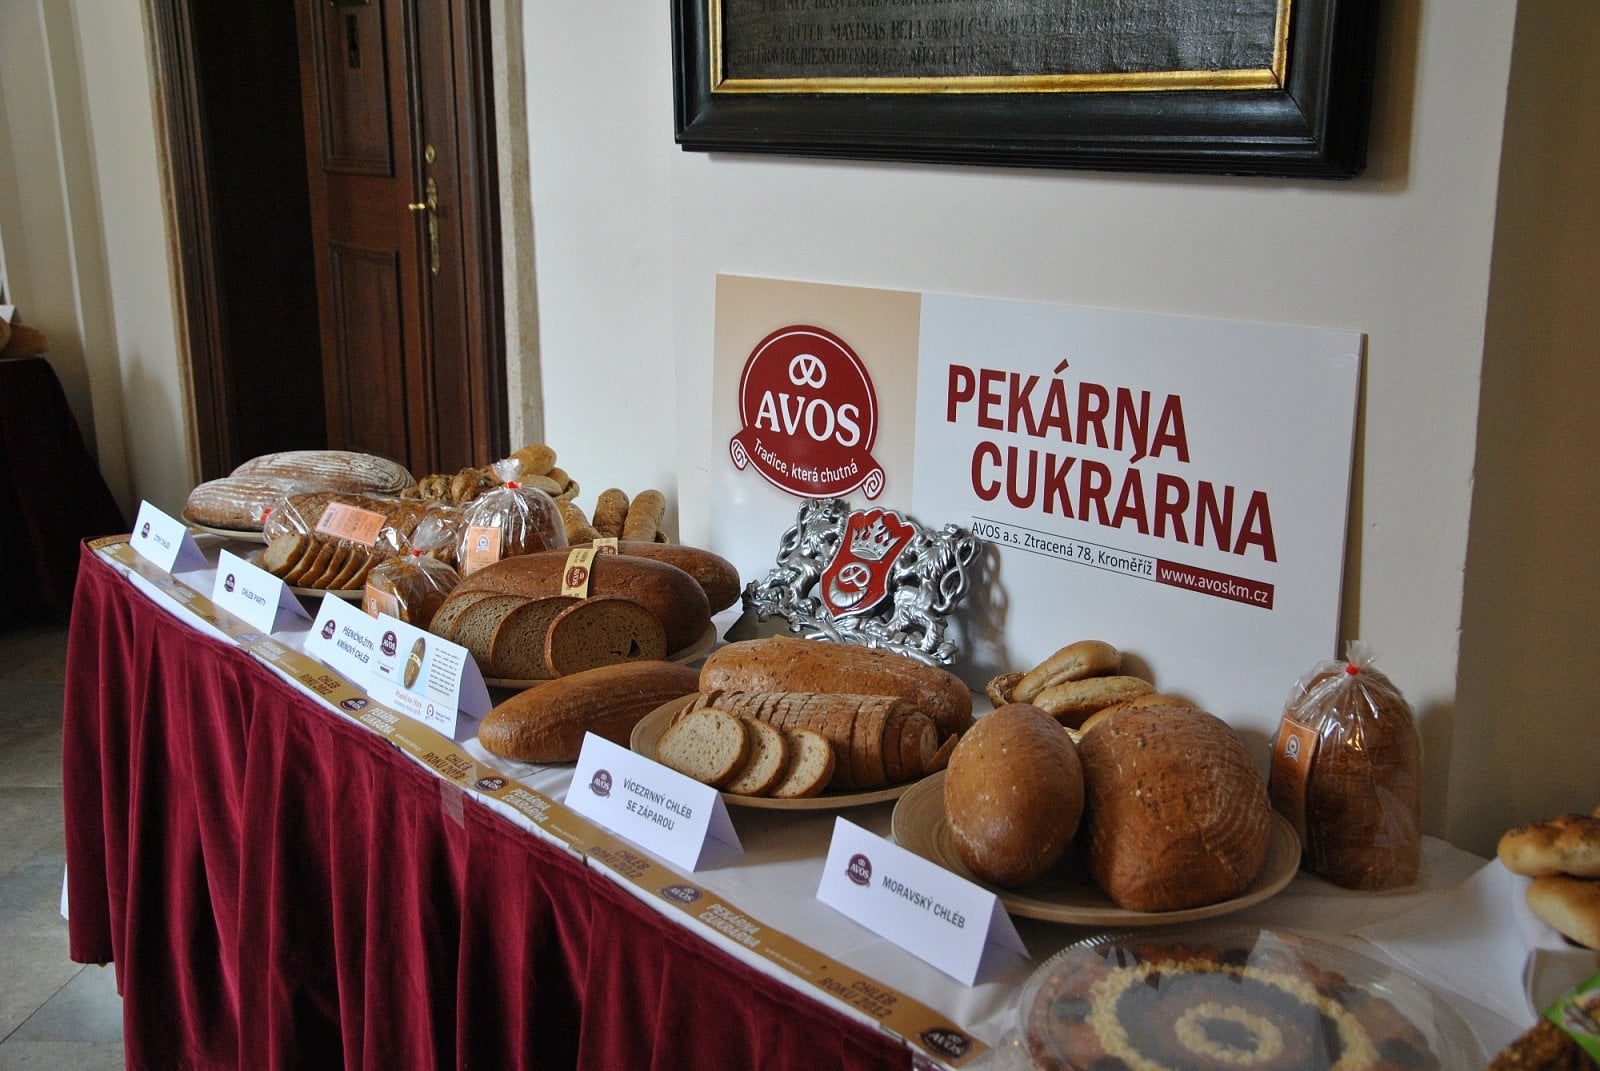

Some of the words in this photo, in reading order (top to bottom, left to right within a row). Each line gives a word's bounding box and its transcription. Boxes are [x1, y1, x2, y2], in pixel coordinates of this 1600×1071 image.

[754, 390, 861, 447] AVOS
[946, 358, 1190, 463] PEKÁRNA
[753, 438, 789, 477] Tradice,
[791, 462, 819, 483] která
[820, 458, 859, 484] chutná
[971, 440, 1278, 564] CUKRÁRNA
[971, 521, 1000, 539] AVOS
[1003, 529, 1021, 545] a.s.
[1024, 533, 1074, 557] Ztracená
[1077, 545, 1095, 564] 78,
[1098, 549, 1153, 576] Kroměříž
[1160, 566, 1268, 604] www.avoskm.cz
[623, 777, 666, 806] VÍCEZRNNÝ
[665, 799, 693, 819] CHLÉB
[626, 800, 638, 812] SE
[637, 805, 675, 831] ZÁPAROU
[850, 863, 870, 879] AVOS
[882, 875, 934, 911] MORAVSKÝ
[933, 903, 966, 929] CHLÉB
[818, 976, 856, 1000] ROKU
[854, 997, 893, 1018] 2012
[927, 1032, 962, 1056] AVOS
